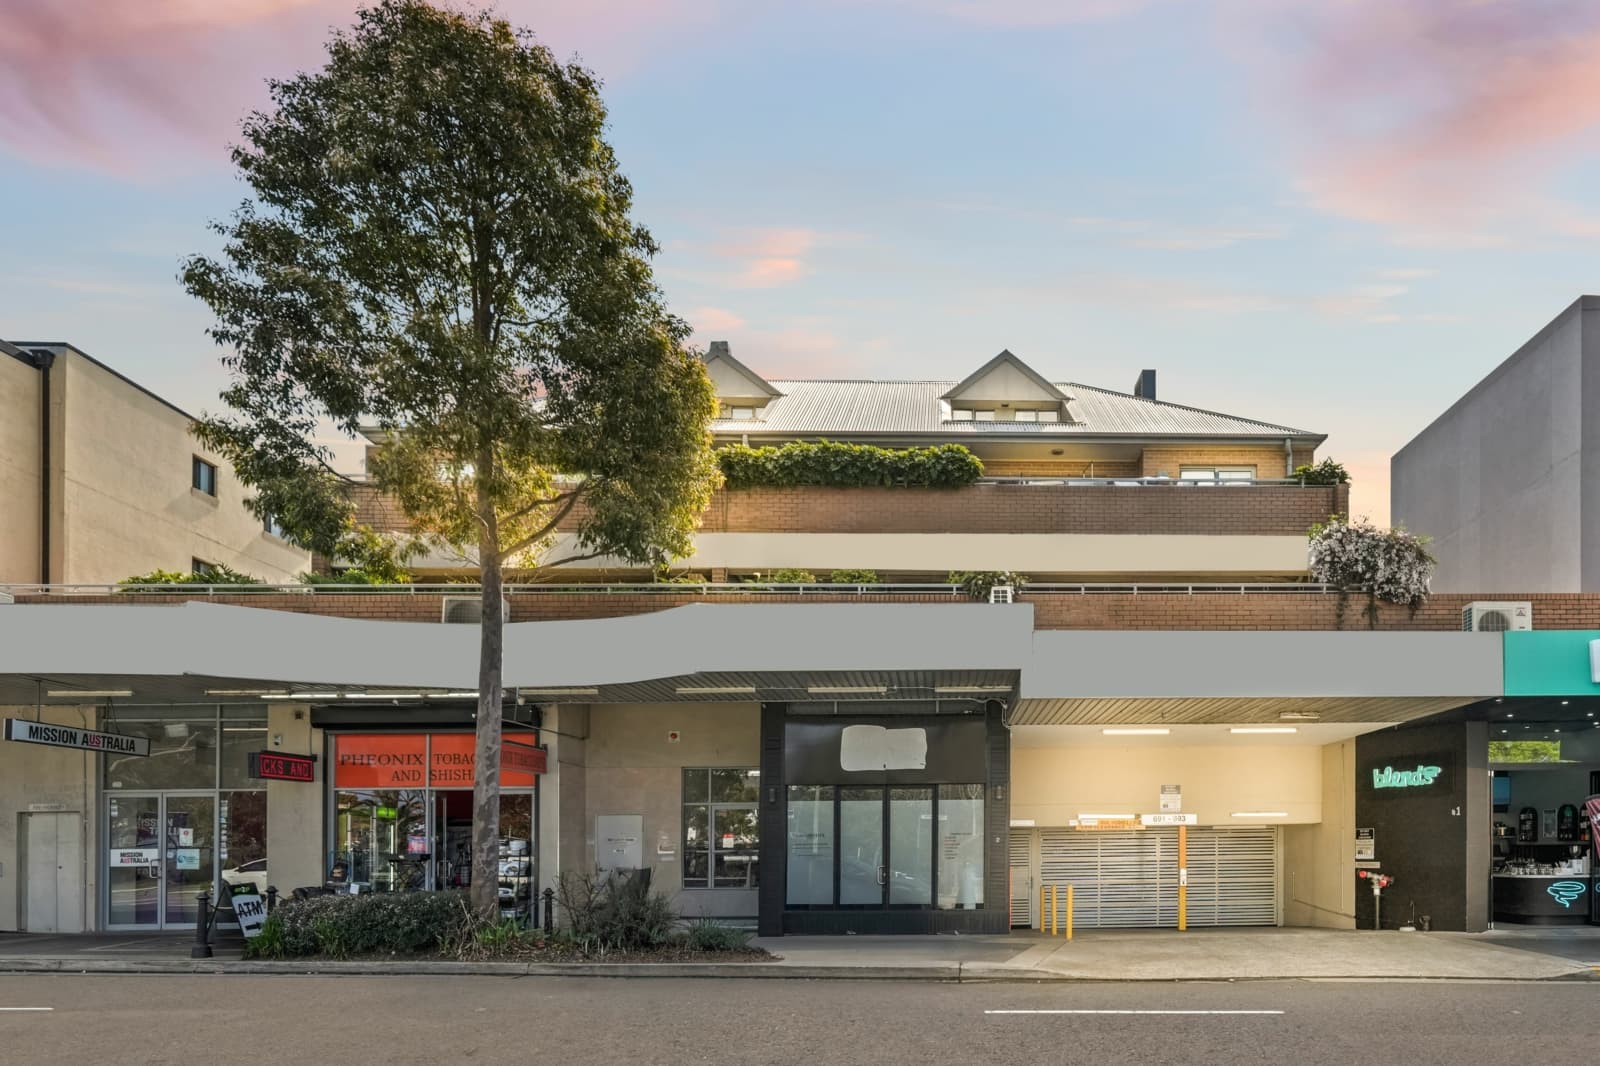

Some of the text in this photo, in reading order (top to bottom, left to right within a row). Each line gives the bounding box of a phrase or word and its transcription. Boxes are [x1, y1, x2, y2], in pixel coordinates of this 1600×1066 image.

[29, 725, 136, 753] MISSION AUSTRALIA
[340, 753, 424, 767] PHEONIX
[291, 762, 309, 778] AND
[391, 769, 475, 782] AND SHISH
[1373, 765, 1437, 788] blends
[238, 896, 263, 919] ATM
